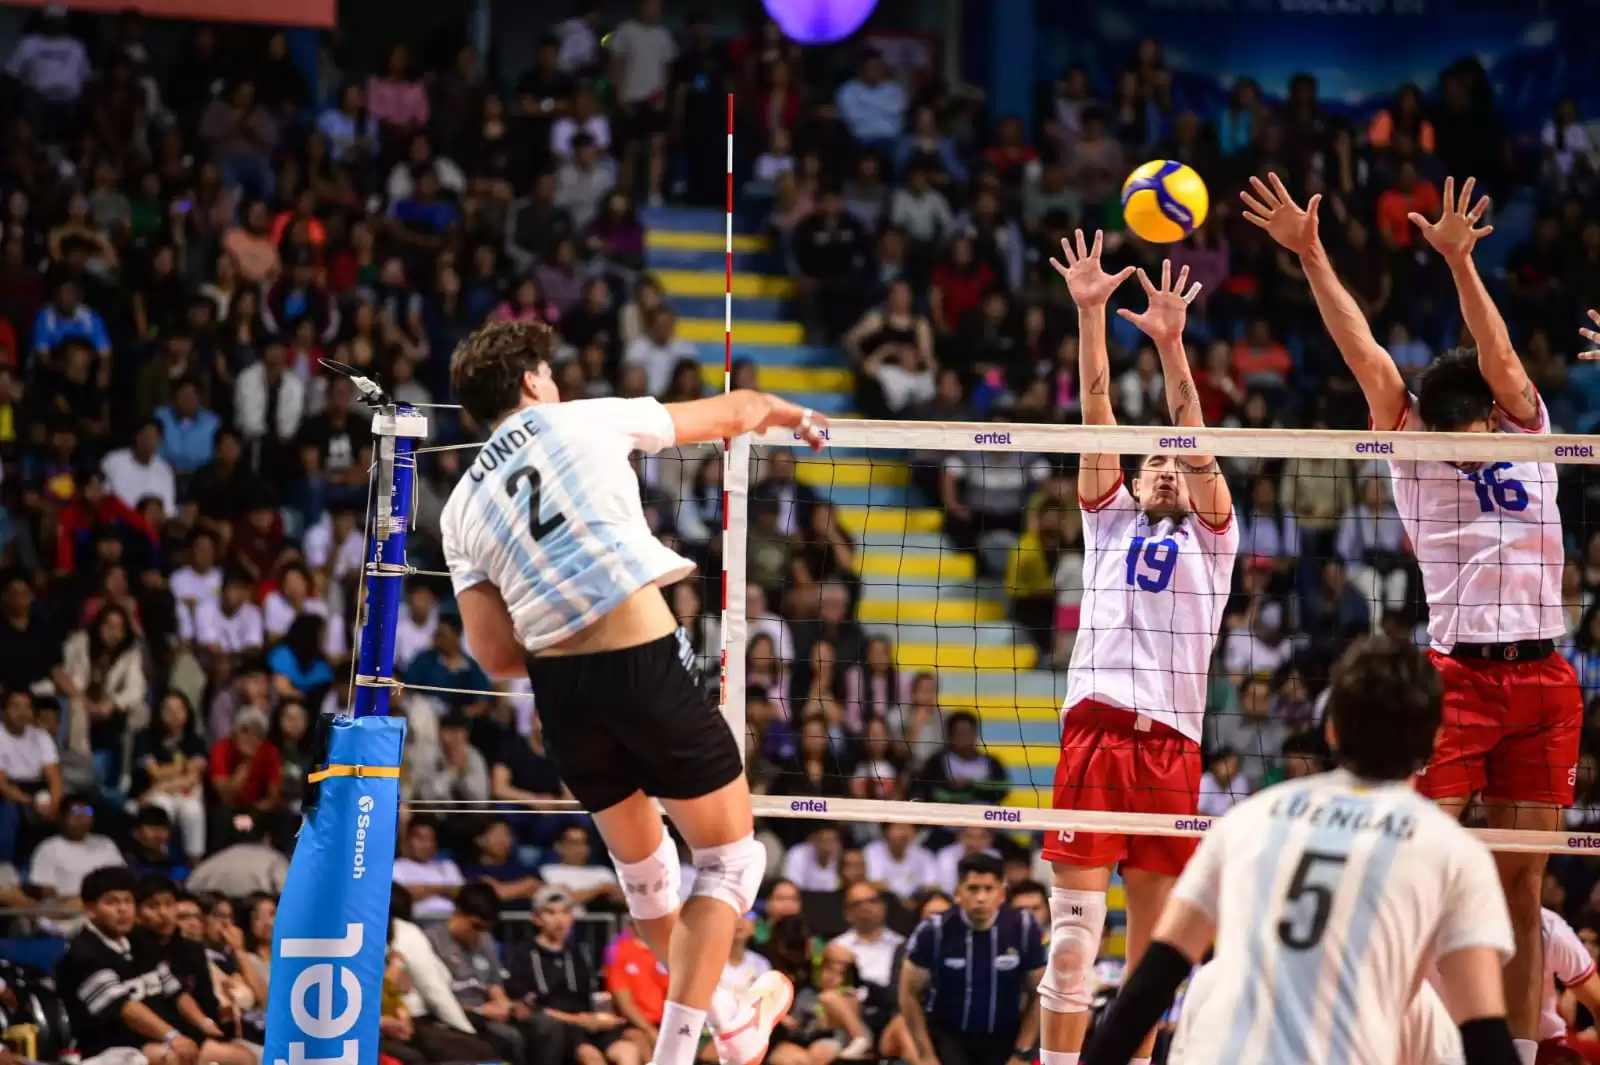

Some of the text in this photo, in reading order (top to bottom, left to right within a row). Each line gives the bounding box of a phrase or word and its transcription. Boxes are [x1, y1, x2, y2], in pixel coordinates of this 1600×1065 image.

[793, 428, 830, 441] eel
[974, 431, 1012, 445] entel
[1159, 436, 1197, 449] entel
[1355, 441, 1395, 454] entel
[469, 420, 541, 483] CONDE
[1554, 444, 1595, 458] entel
[1468, 462, 1529, 512] 16
[506, 465, 568, 542] 2
[1126, 536, 1179, 593] 19
[791, 800, 828, 813] entel
[984, 809, 1021, 823] entel
[1175, 818, 1212, 831] entel
[353, 814, 371, 879] Senoh
[1276, 850, 1349, 951] 5
